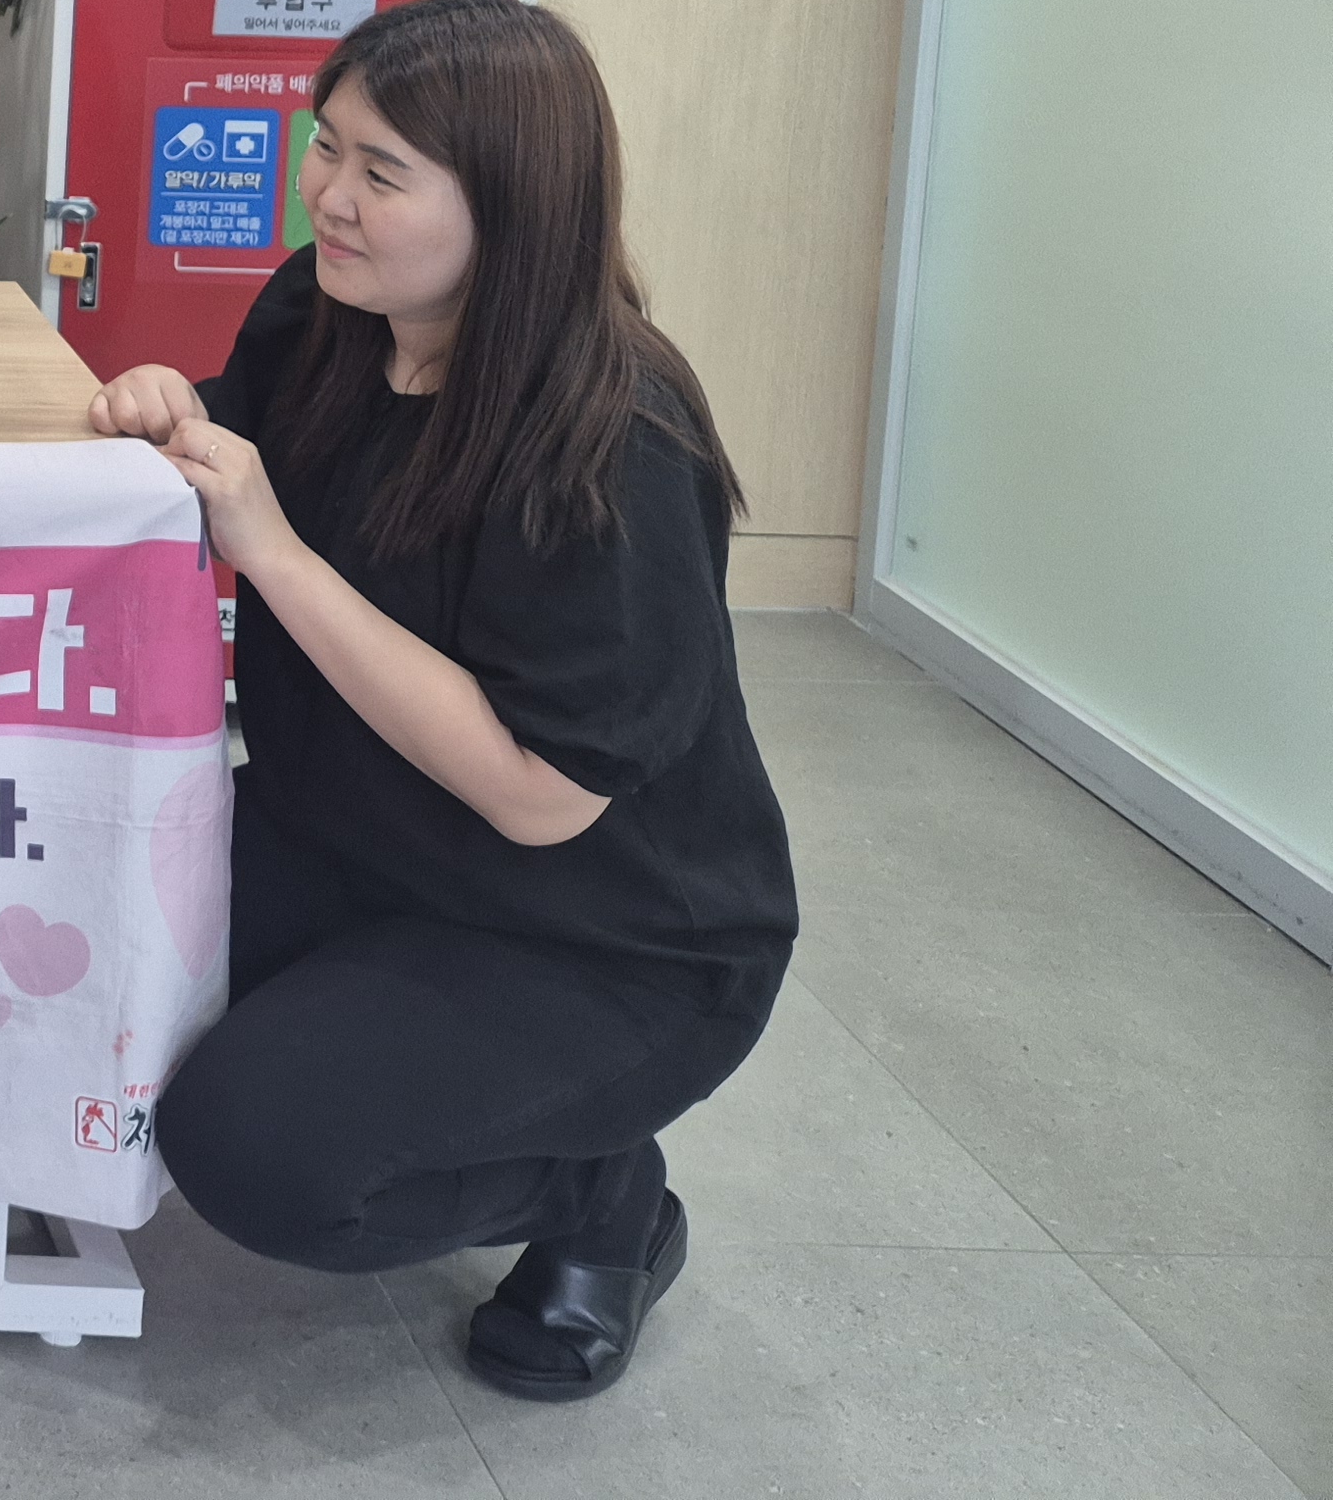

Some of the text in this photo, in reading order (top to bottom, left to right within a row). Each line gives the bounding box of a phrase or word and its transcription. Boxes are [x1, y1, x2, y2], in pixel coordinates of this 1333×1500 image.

[244, 17, 341, 32] 밀어서 넣어주세요
[215, 73, 284, 95] 폐의약품
[165, 170, 261, 190] 알약/가루약
[212, 201, 248, 214] 그대로
